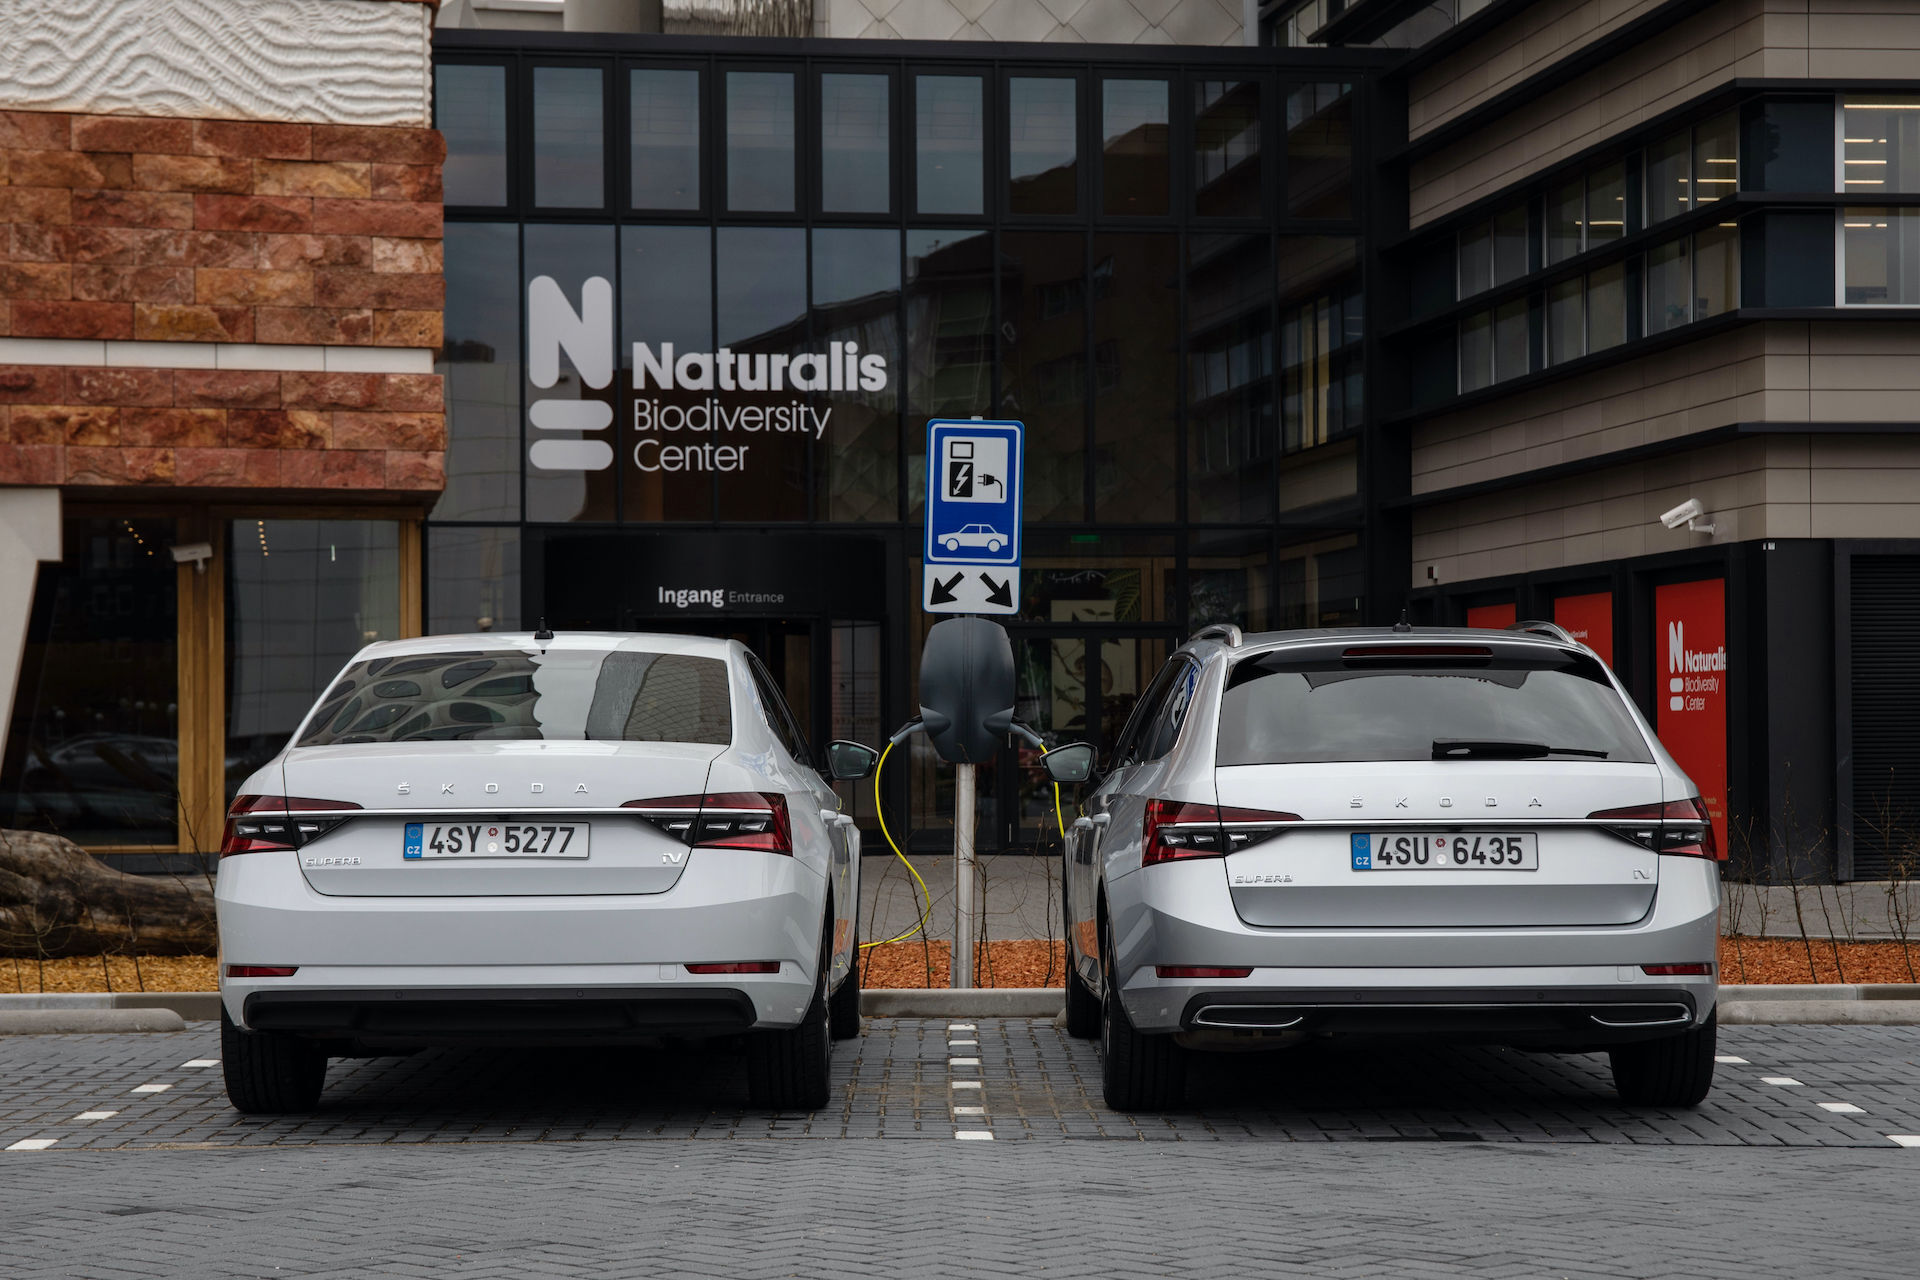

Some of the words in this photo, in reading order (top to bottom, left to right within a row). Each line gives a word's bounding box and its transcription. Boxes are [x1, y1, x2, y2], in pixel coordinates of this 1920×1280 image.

[632, 341, 888, 392] Naturalis
[634, 398, 832, 440] Biodiversity
[633, 439, 749, 472] Center
[658, 586, 724, 608] Ingang
[728, 591, 785, 603] Entrance
[1685, 676, 1720, 694] Biodiversity
[1685, 695, 1706, 711] Center
[397, 782, 589, 795] ŠKODA
[1350, 796, 1543, 808] ŠKODA
[406, 845, 421, 855] CZ
[429, 826, 482, 854] 4SY
[504, 826, 576, 854] 5277
[305, 856, 362, 867] SUPERB
[1355, 856, 1370, 866] CZ
[1377, 837, 1430, 865] 4SU
[1452, 837, 1523, 865] 6435
[1234, 874, 1293, 884] SUPERB
